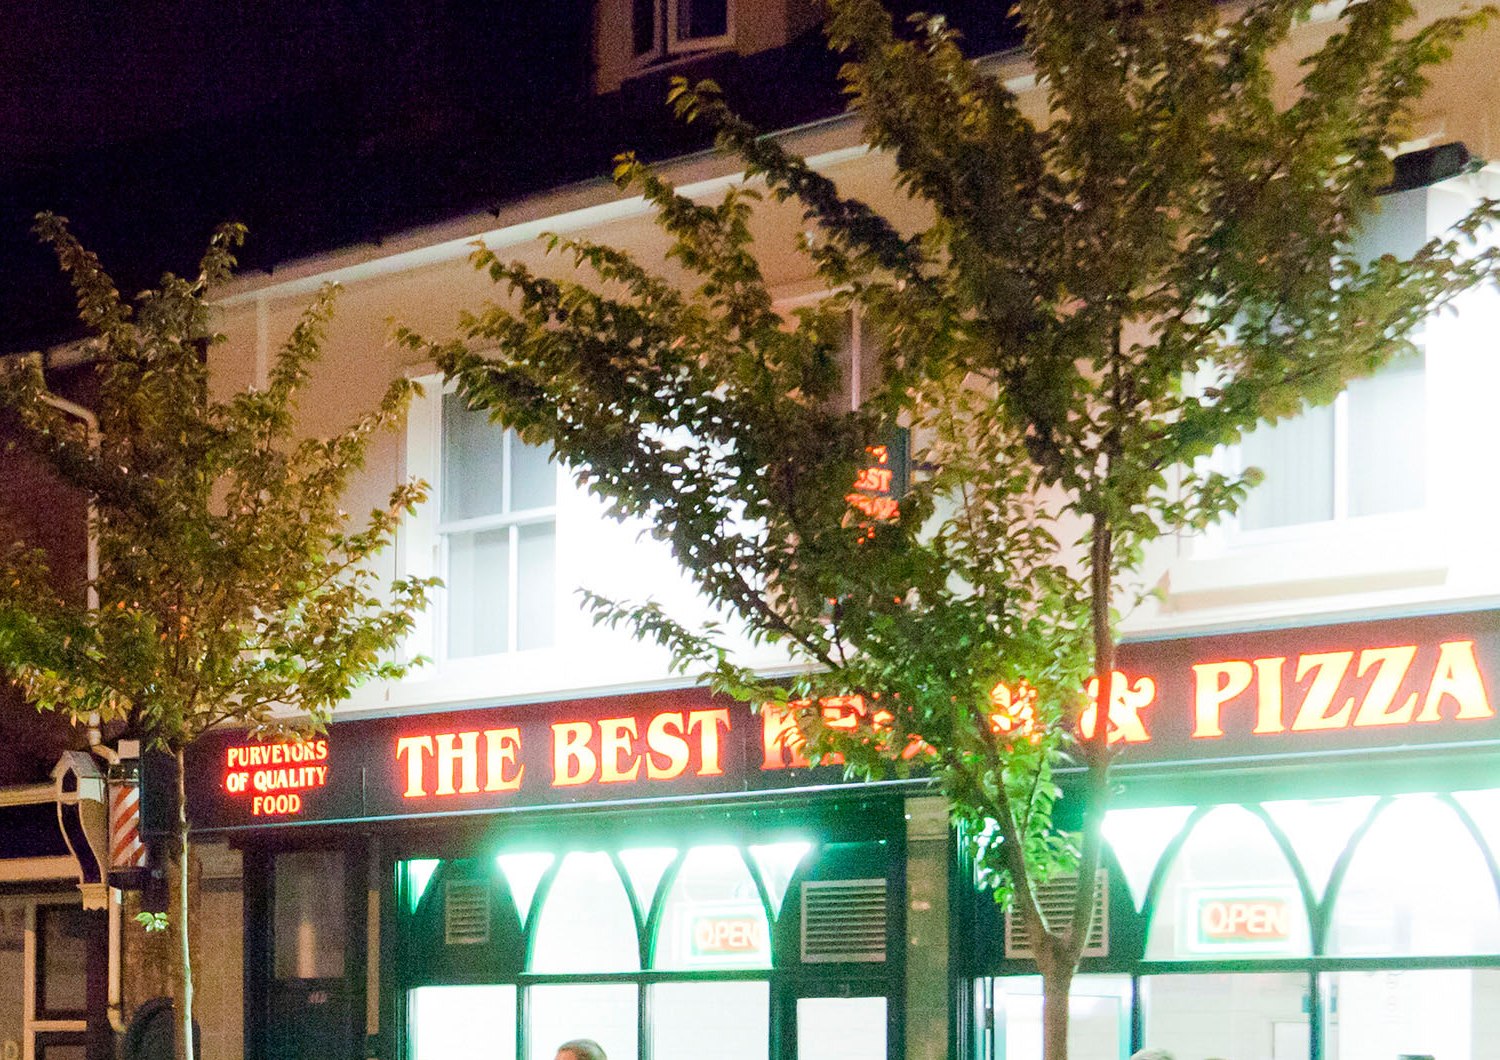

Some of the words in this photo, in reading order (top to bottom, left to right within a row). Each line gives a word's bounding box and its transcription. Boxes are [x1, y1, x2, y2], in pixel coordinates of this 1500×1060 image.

[394, 726, 526, 799] THE
[550, 707, 732, 788] BEST
[1190, 640, 1494, 739] PIZZA
[227, 739, 328, 768] PURVEYORS
[226, 772, 249, 793] OF
[253, 766, 328, 792] QUALITY
[252, 794, 301, 816] FOOD
[1200, 901, 1289, 934] OPEN
[695, 919, 761, 948] OPEN
